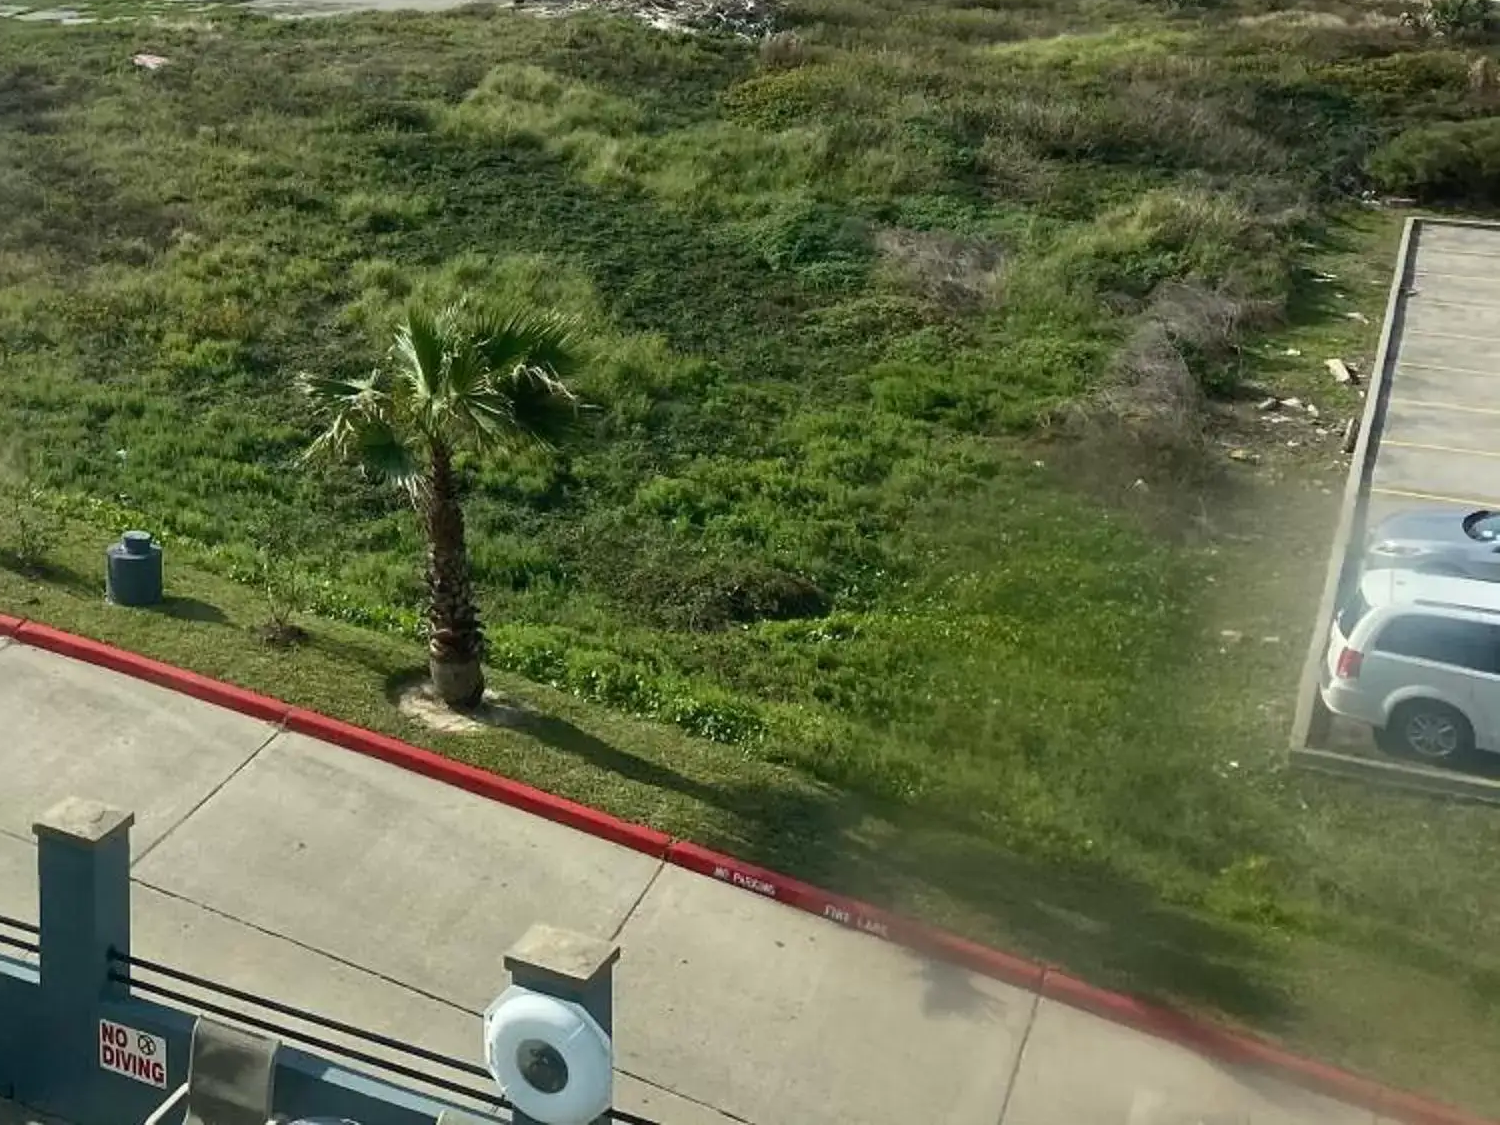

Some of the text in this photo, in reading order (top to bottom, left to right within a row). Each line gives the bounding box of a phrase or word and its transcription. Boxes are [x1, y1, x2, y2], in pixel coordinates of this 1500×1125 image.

[733, 872, 776, 895] PARKING
[102, 1023, 127, 1048] NO
[103, 1045, 165, 1083] DIVING
